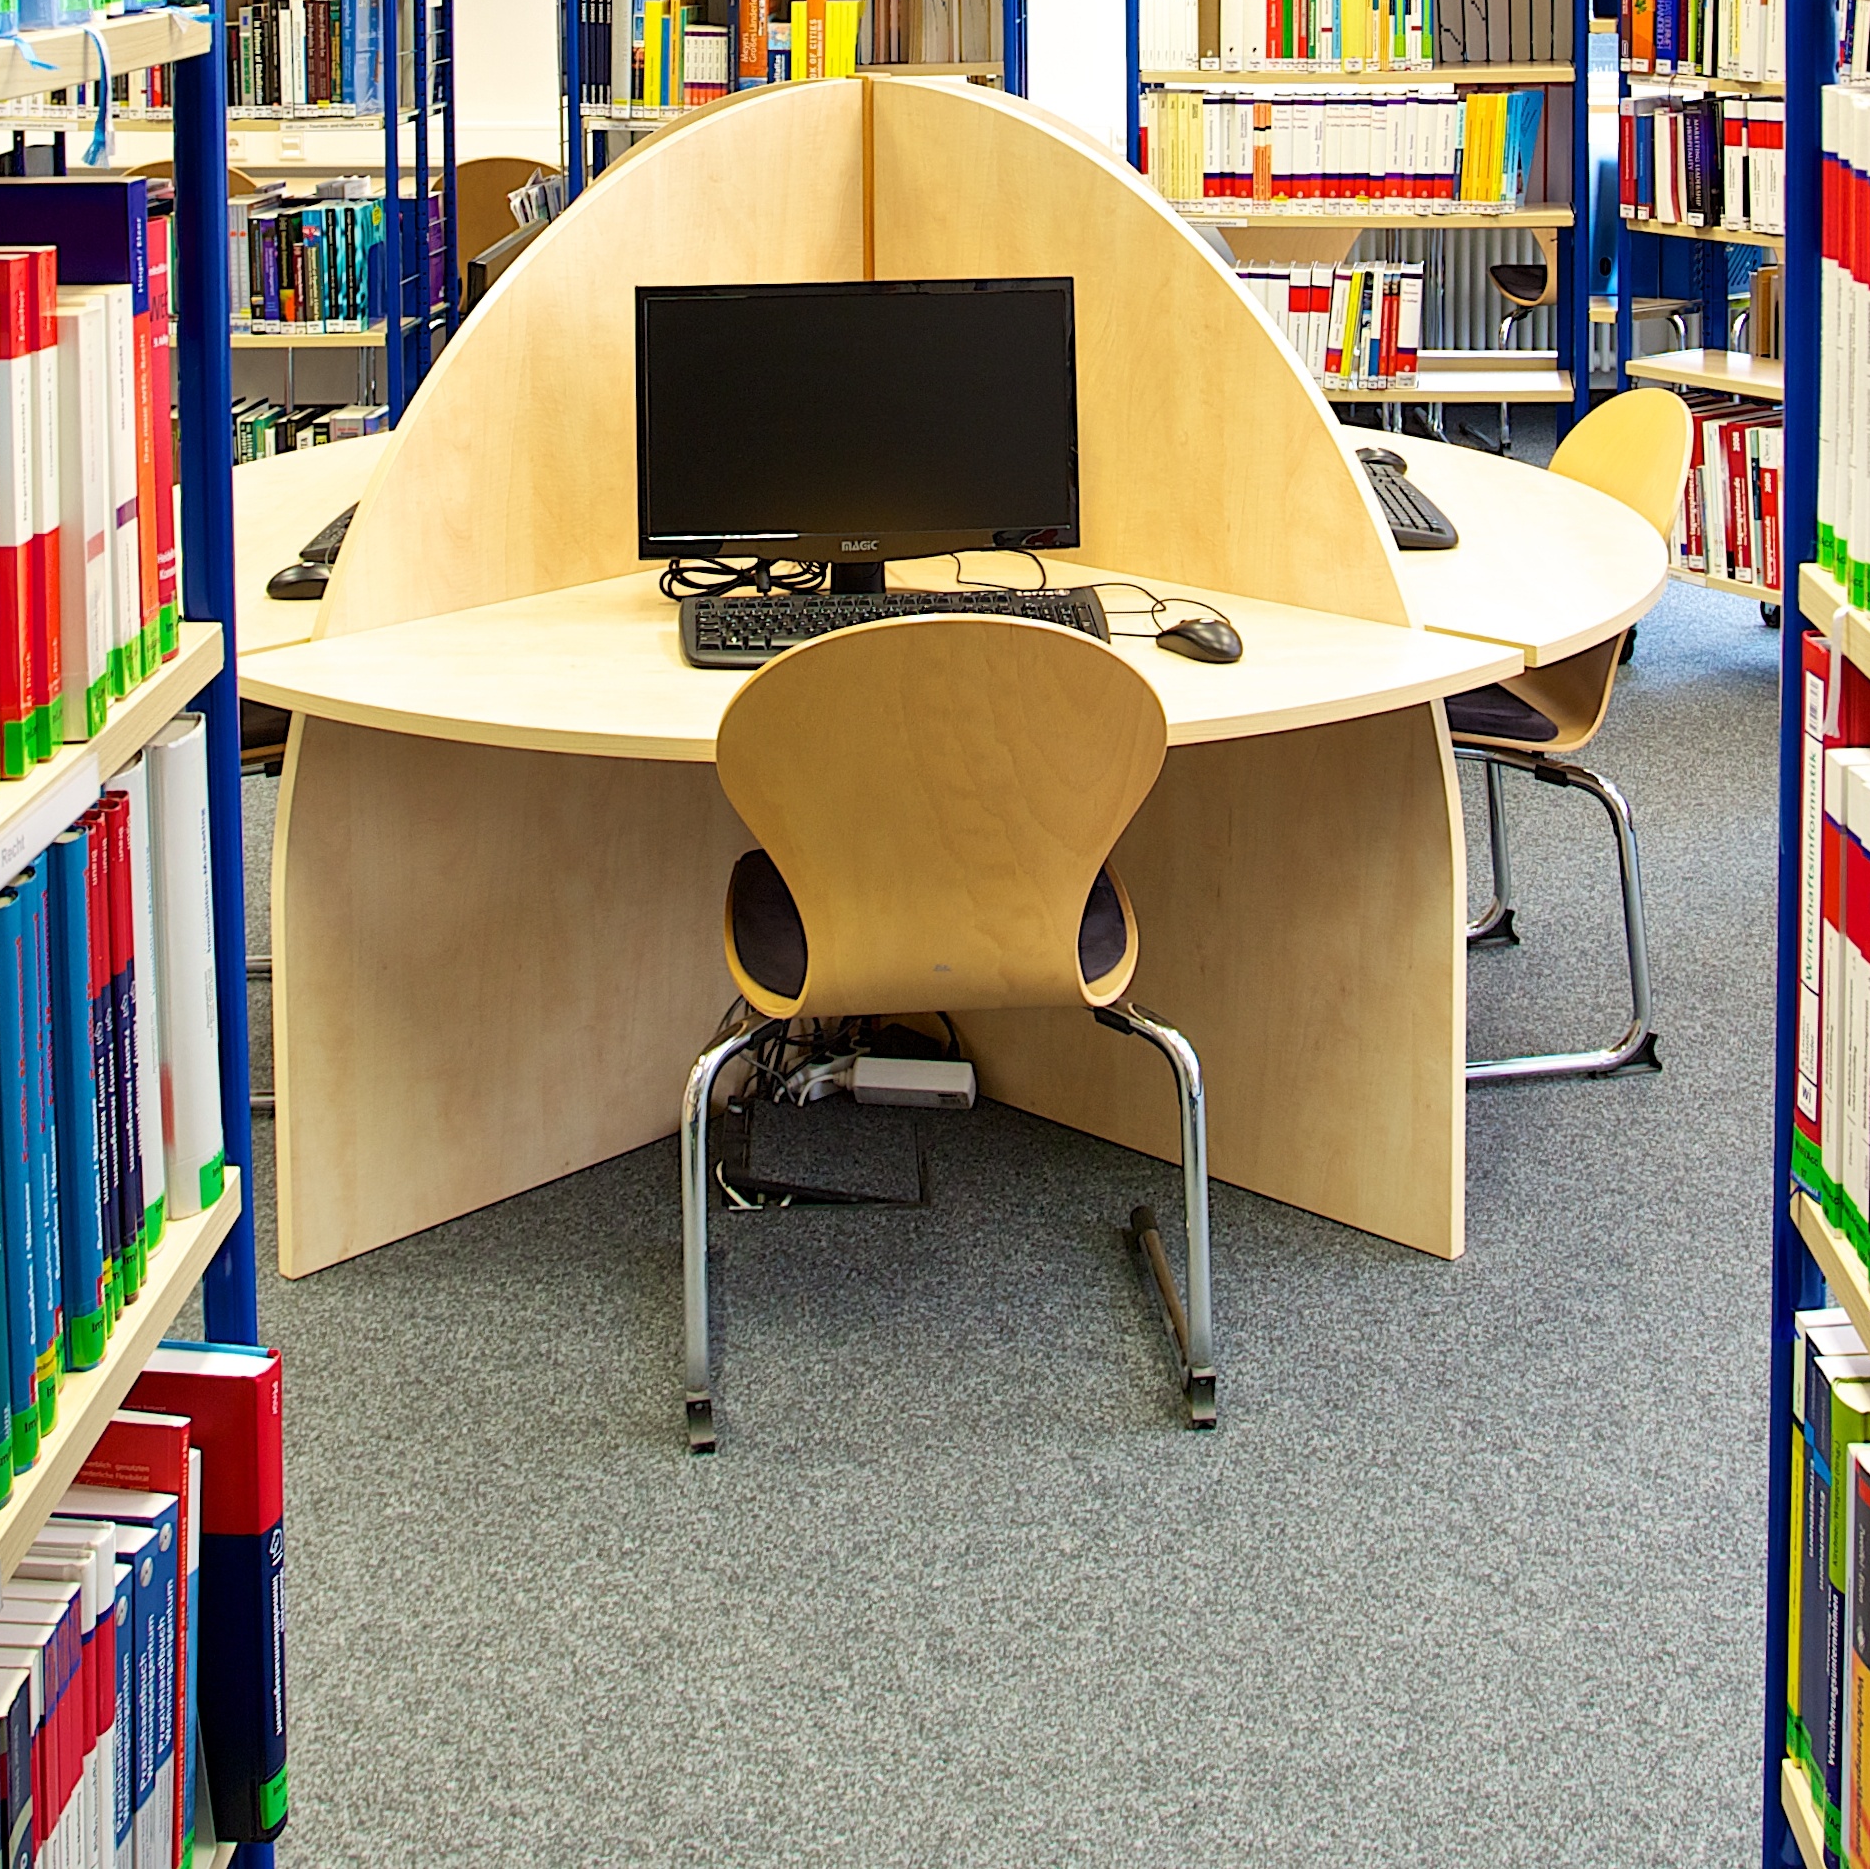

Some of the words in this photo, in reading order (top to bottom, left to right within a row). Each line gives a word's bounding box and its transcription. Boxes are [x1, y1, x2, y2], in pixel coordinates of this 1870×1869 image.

[840, 538, 880, 552] MAGIC
[1, 834, 26, 867] Recht
[1800, 749, 1820, 983] Wirtschaftsinformatik
